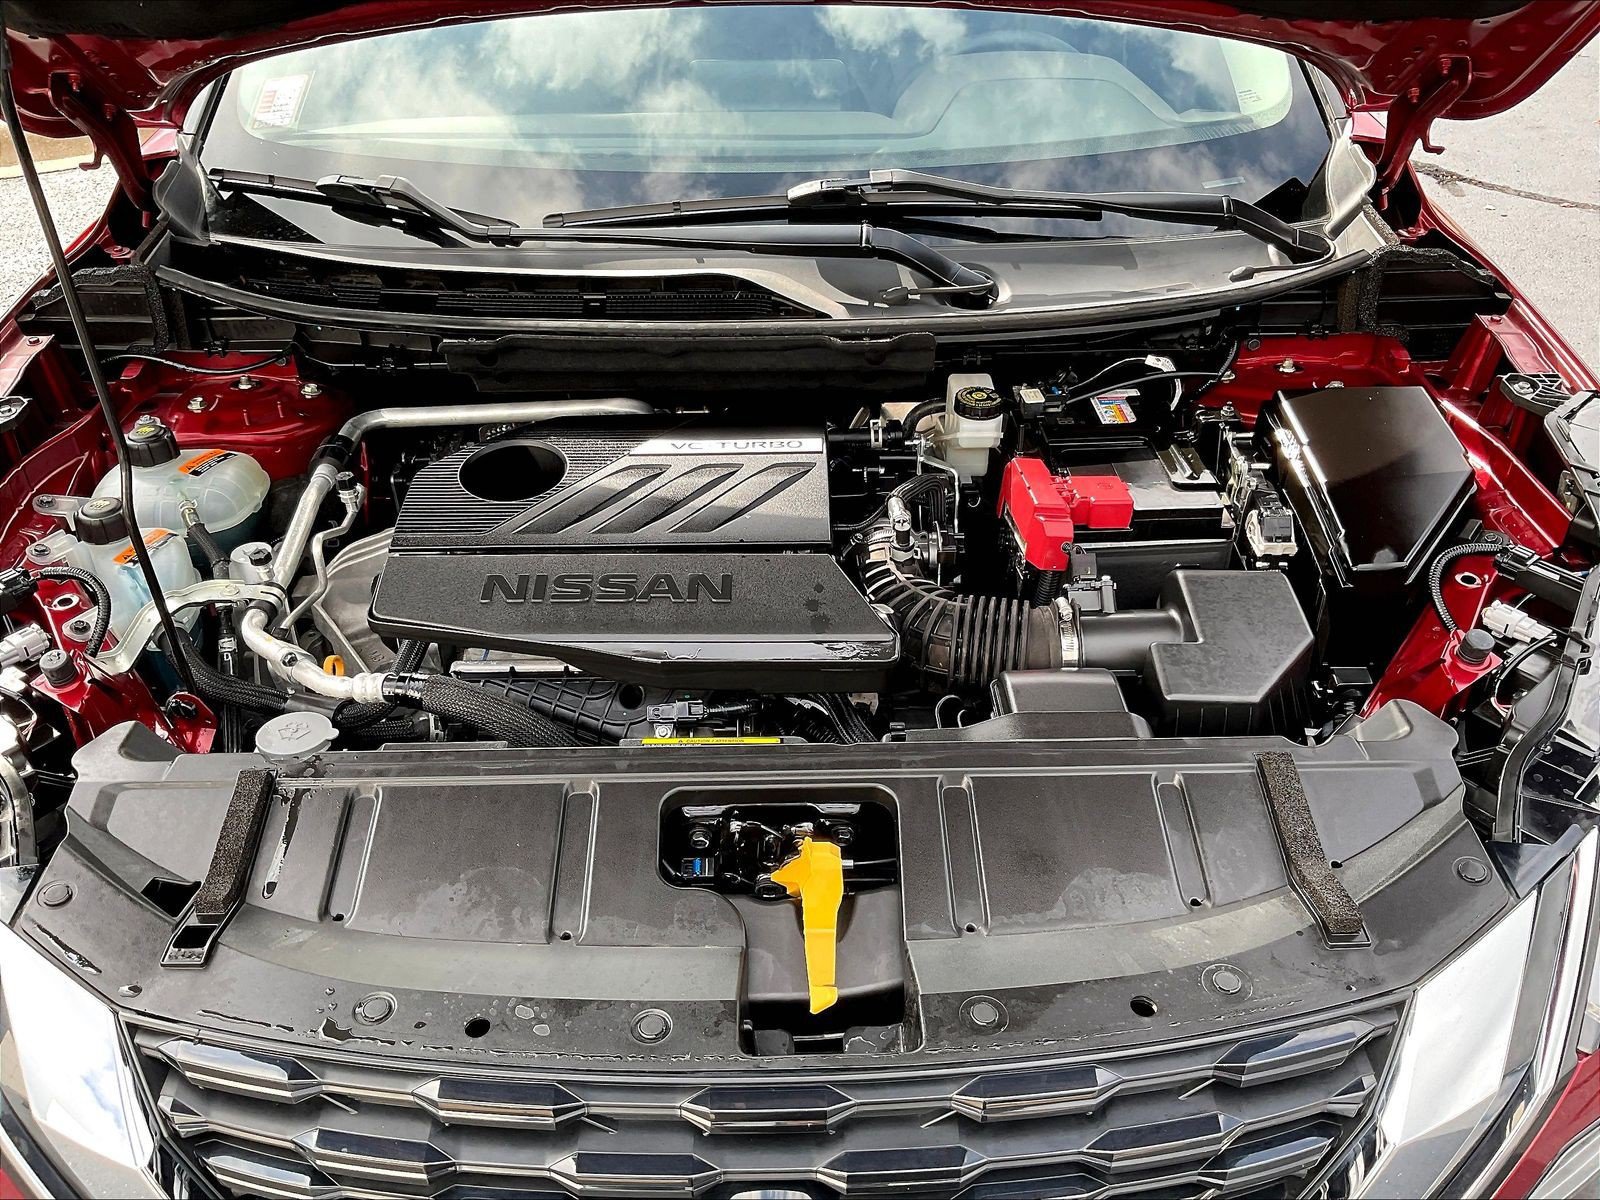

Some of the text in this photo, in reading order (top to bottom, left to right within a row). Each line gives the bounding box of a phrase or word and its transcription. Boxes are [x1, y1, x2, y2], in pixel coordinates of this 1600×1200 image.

[670, 440, 803, 450] VC TURBO
[479, 573, 734, 603] NISSAN
